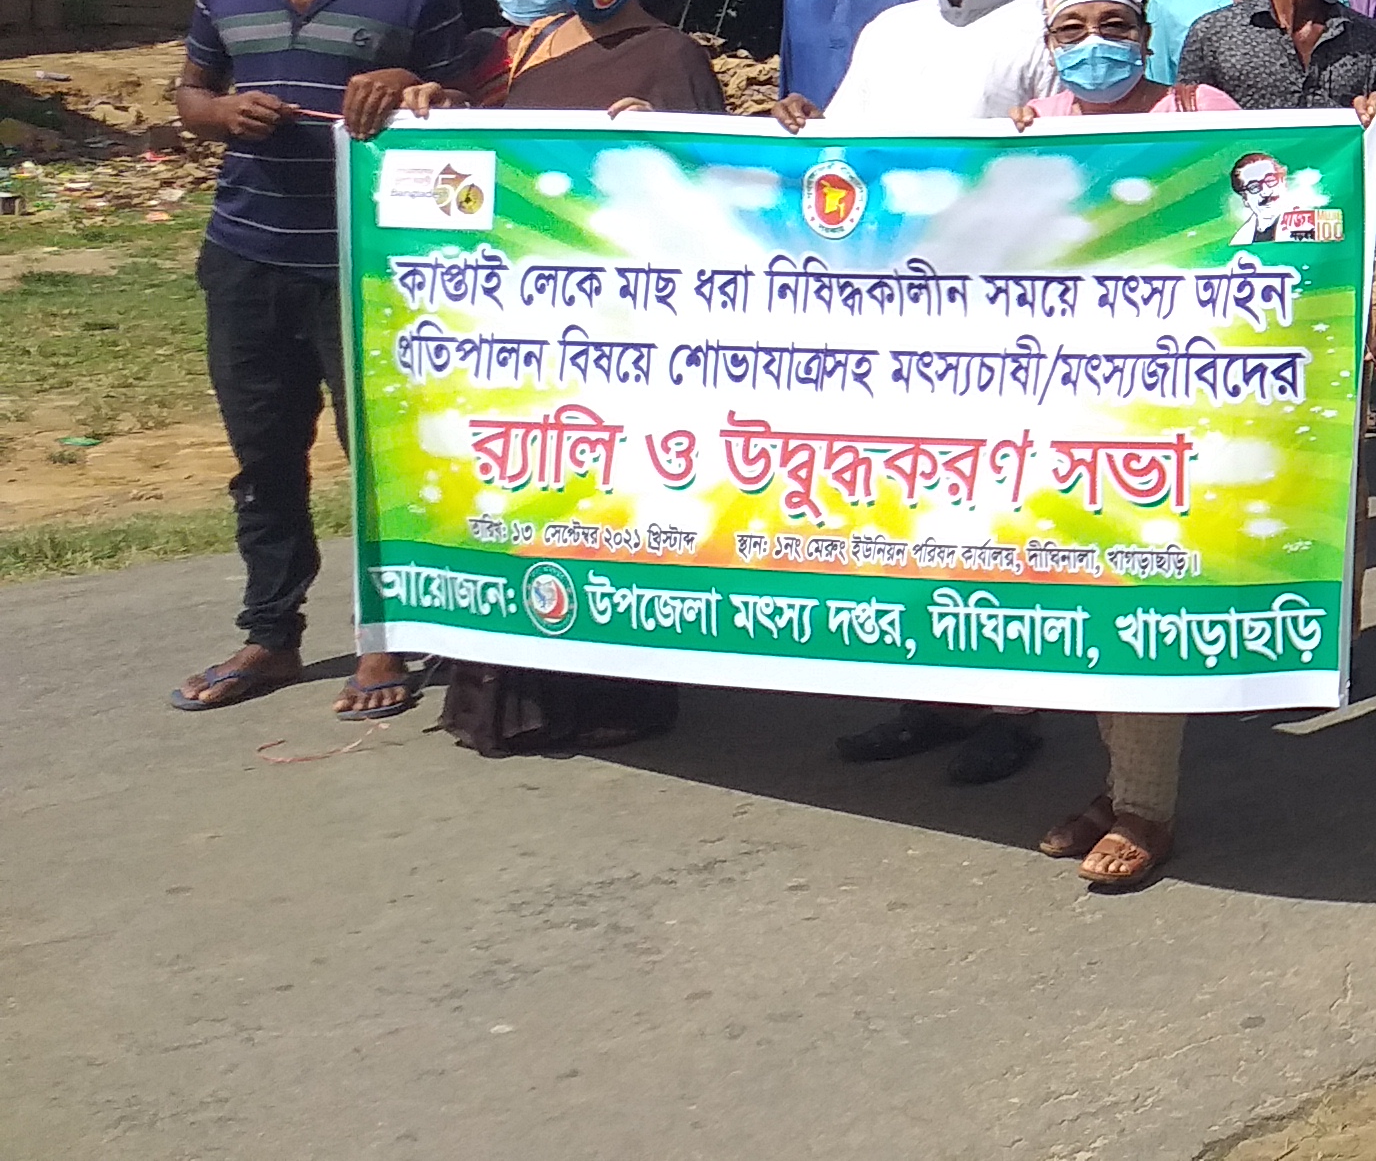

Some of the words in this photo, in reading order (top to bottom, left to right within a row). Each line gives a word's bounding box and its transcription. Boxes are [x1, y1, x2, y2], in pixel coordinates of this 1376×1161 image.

[396, 244, 508, 310] কাপ্তাই
[519, 265, 605, 308] লেকে
[615, 263, 682, 314] মাছ
[697, 267, 754, 313] ধরা
[765, 255, 971, 319] নিষিদ্ধকালীন
[982, 273, 1085, 319] সময়ে
[1095, 272, 1185, 319] মৎস্য
[1195, 259, 1297, 325] আইন
[397, 320, 549, 384] প্রতিপালন
[559, 325, 656, 385] বিষয়ে
[669, 340, 879, 398] শোভাযাত্রাসহ
[645, 429, 697, 486] ও
[720, 410, 1034, 519] উদ্বুদ্ধকরণ
[1050, 432, 1195, 510] সভা
[512, 523, 533, 542] ১৩
[544, 520, 599, 546] সেপ্টেম্বর
[604, 528, 640, 550] ২০২১
[647, 523, 697, 553] খ্রিস্টাব্দ
[775, 536, 801, 560] ১নং
[807, 538, 845, 561] মেরুং
[851, 535, 908, 563] ইউনিয়ন
[912, 537, 958, 566] পরিষদ
[961, 539, 1022, 572] কার্যালয়,
[1026, 541, 1102, 576] দীঘিনালা,
[584, 570, 722, 638] উপজেলা
[730, 594, 819, 645] মৎস্য
[827, 597, 918, 660] দপ্তর,
[928, 588, 1099, 669] দীঘিনালা,
[1115, 593, 1326, 669] খাগড়াছড়ি
